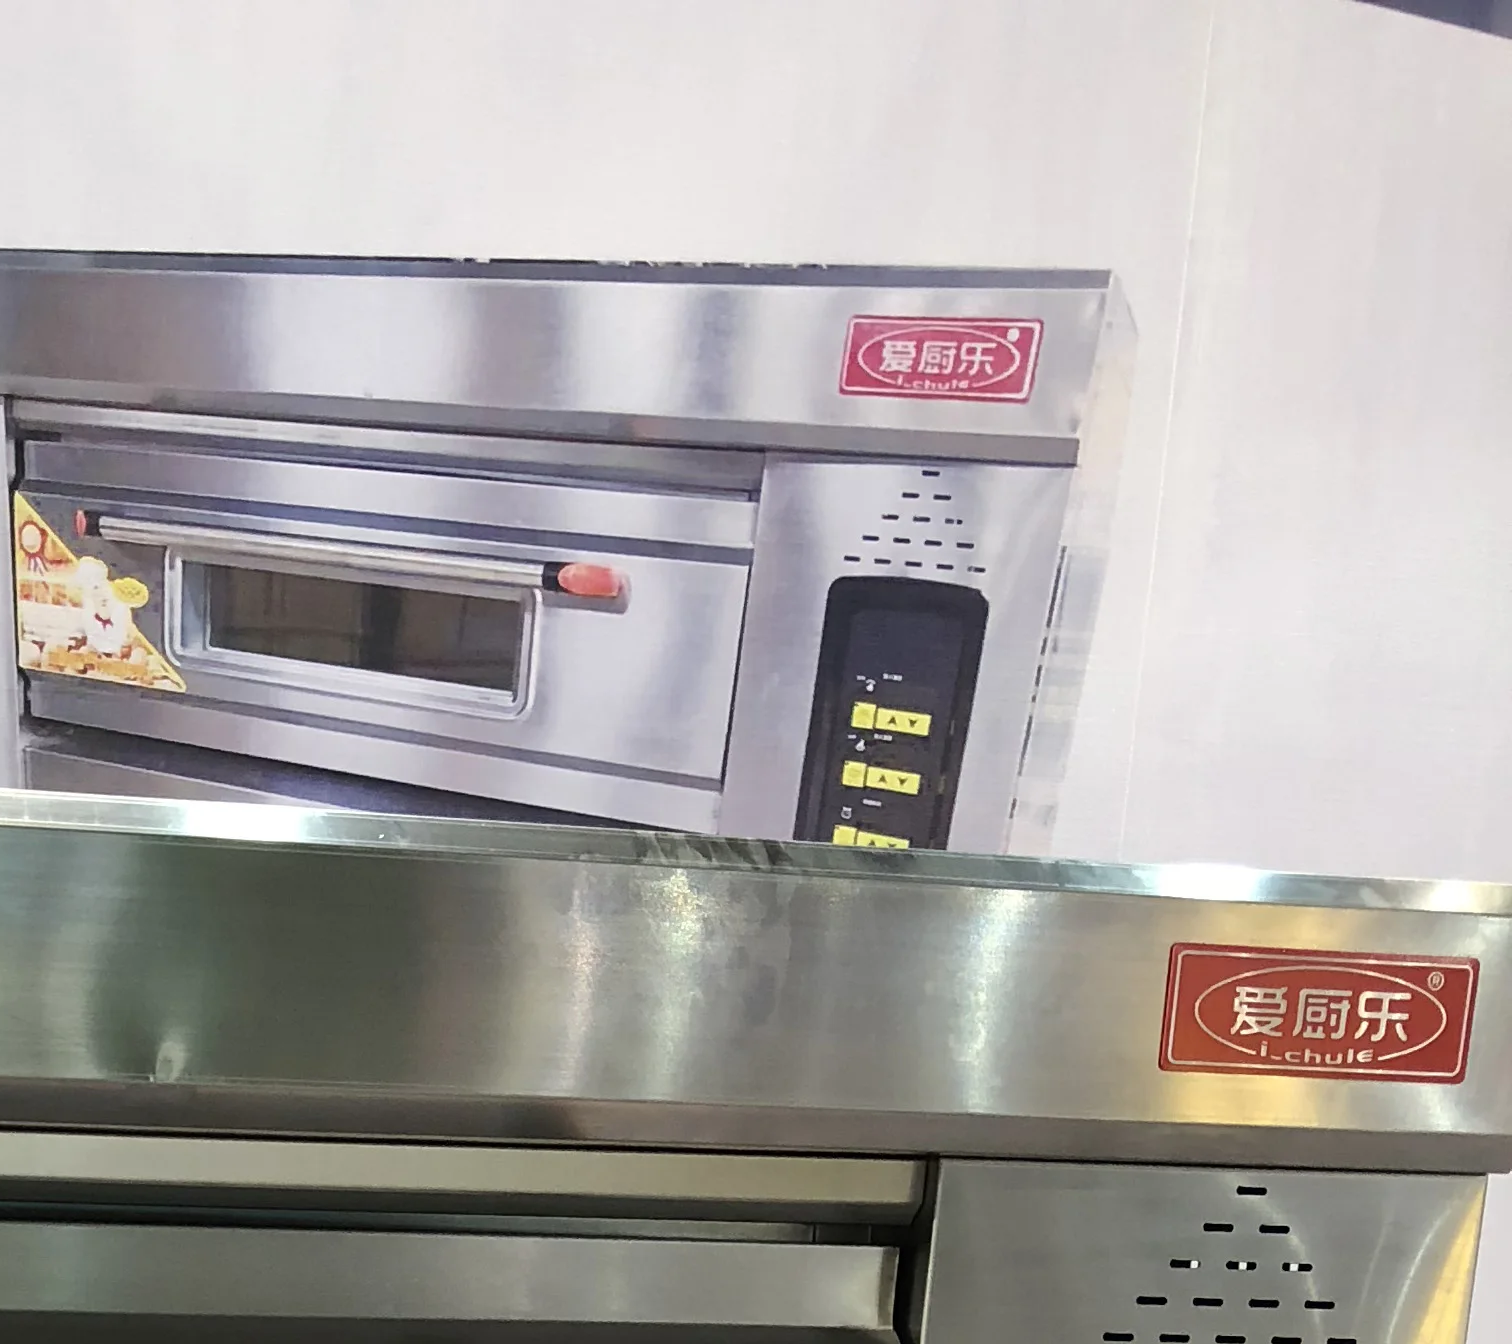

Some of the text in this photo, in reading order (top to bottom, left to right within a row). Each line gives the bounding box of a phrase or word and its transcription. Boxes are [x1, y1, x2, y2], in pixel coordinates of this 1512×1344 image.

[879, 340, 997, 376] 爱厨乐
[1229, 985, 1412, 1042] 爱厨乐
